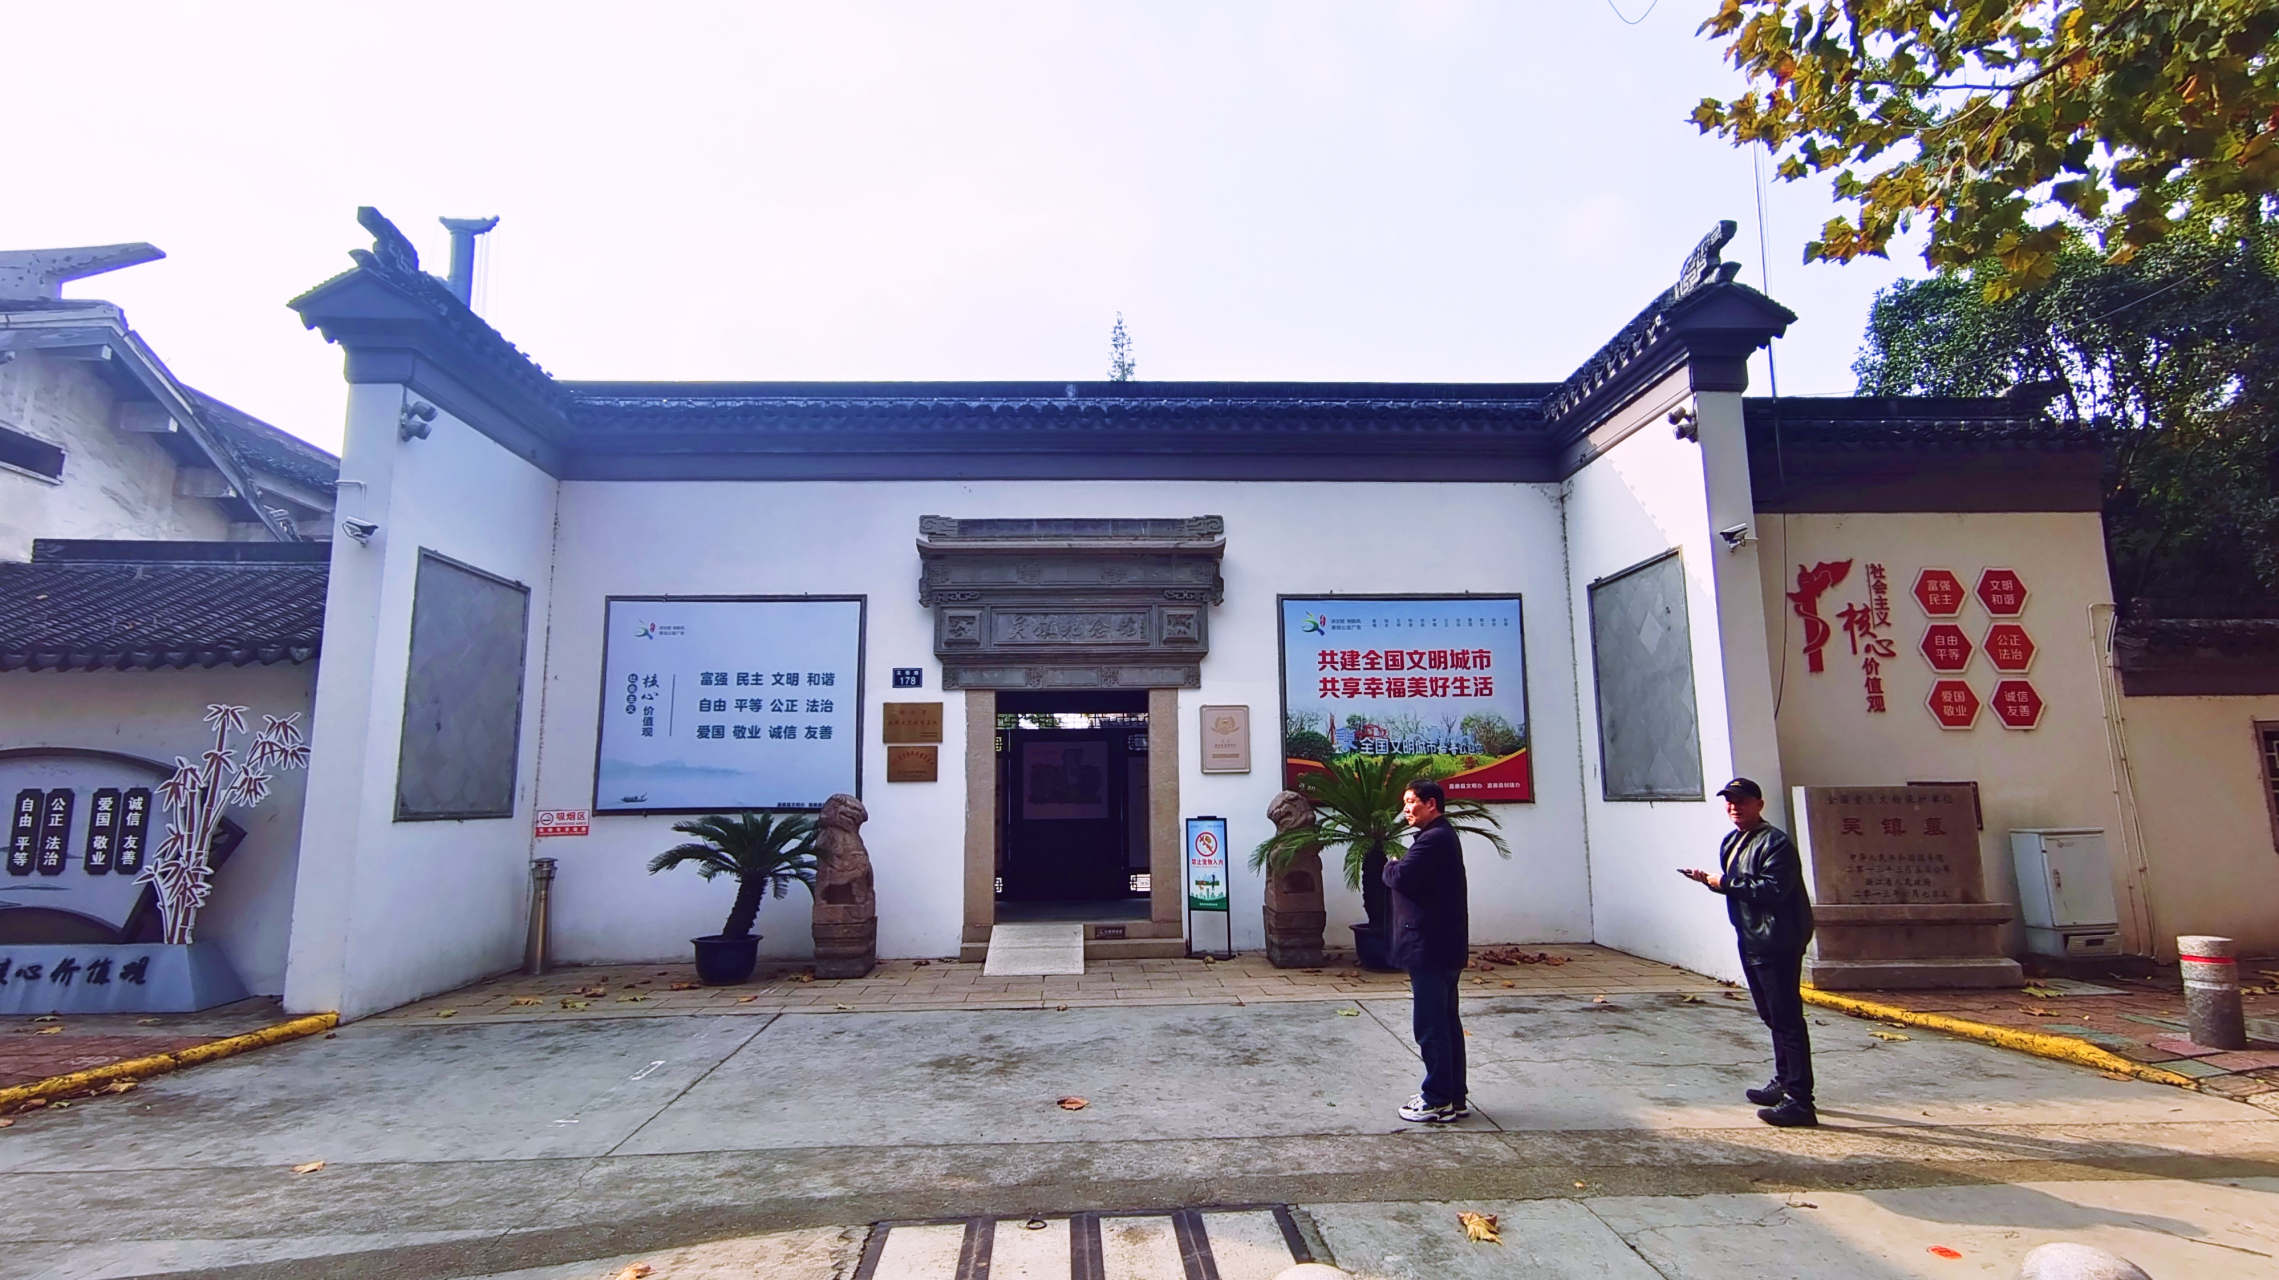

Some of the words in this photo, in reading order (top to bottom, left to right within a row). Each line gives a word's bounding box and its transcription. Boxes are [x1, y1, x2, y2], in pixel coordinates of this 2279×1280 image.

[1927, 580, 1951, 591] 富强
[1989, 580, 2014, 591] 文明
[1870, 563, 1891, 627] 社会主义
[1929, 594, 1953, 605] 民主
[1991, 594, 2015, 605] 和谐
[1009, 615, 1137, 639] 吴镇纪念馆
[1934, 635, 1958, 646] 自由
[1997, 635, 2021, 646] 公正
[1318, 649, 1491, 671] 共建全国文明城市
[1836, 603, 1896, 712] 核心价值观
[1936, 649, 1960, 660] 平等
[1999, 649, 2022, 660] 法治
[700, 672, 729, 686] 富强
[736, 672, 764, 686] 民主
[771, 672, 800, 686] 文明
[807, 672, 835, 686] 和谐
[900, 677, 916, 685] 178
[1319, 676, 1493, 698] 共享幸福美好生活
[1941, 691, 1965, 702] 爱国
[2004, 691, 2028, 702] 诚信
[641, 673, 659, 737] 核心价值观
[699, 698, 726, 713] 自由
[734, 698, 763, 713] 平等
[770, 698, 799, 713] 公正
[805, 698, 834, 713] 法治
[1943, 705, 1967, 716] 敬业
[2006, 705, 2031, 717] 友善
[696, 725, 725, 739] 爱国
[732, 725, 761, 739] 敬业
[768, 725, 797, 739] 诚信
[804, 725, 833, 739] 友善
[1827, 794, 1953, 805] 全国重点文物保护单位
[19, 798, 34, 827] 自由
[48, 798, 66, 827] 公正
[95, 797, 113, 827] 爱国
[126, 796, 144, 826] 诚信
[556, 812, 585, 820] 吸烟区
[1841, 817, 1946, 836] 吴镇墓
[13, 836, 30, 866] 平等
[43, 836, 61, 866] 法治
[90, 836, 109, 865] 敬业
[121, 835, 139, 865] 友善
[1191, 858, 1224, 866] 禁止宠物入内
[1865, 878, 1931, 887] 浙江省人民政府
